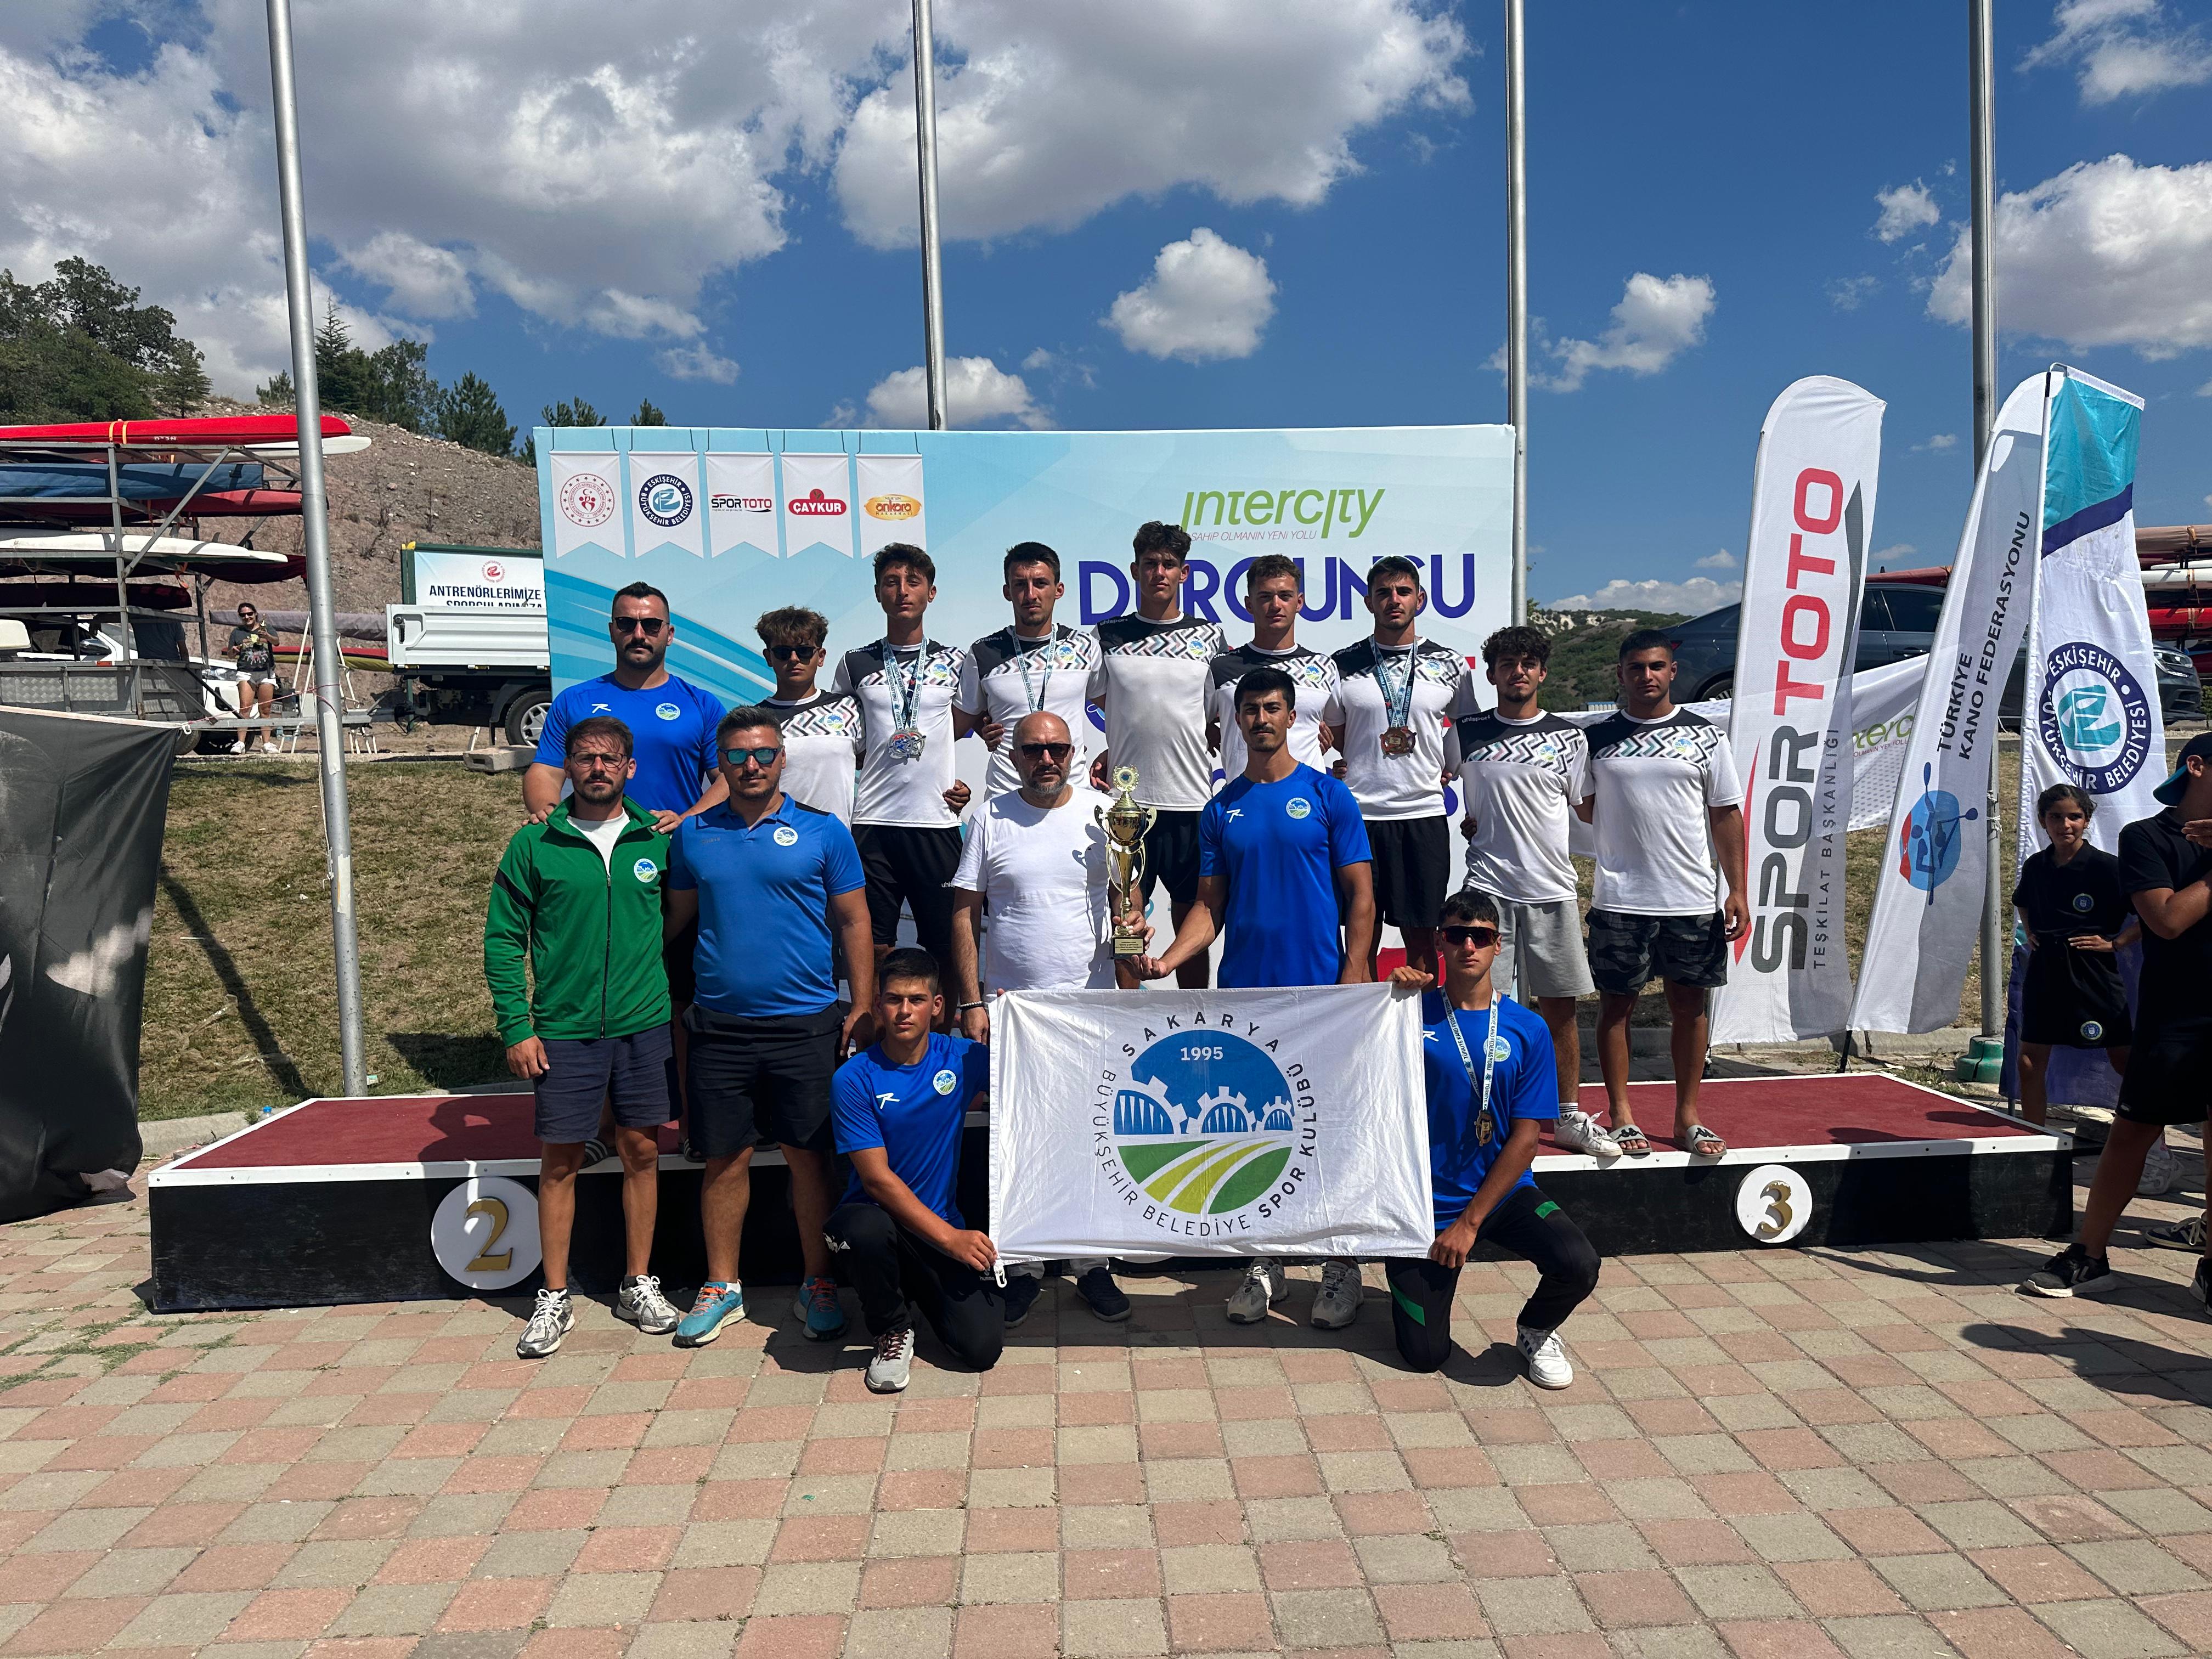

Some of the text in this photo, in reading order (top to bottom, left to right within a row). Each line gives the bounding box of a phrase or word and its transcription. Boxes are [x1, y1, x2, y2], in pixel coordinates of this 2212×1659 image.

[647, 475, 682, 488] ESKİŞEHİR
[640, 493, 670, 526] BÜYÜKŞEHİR
[671, 492, 692, 525] BELEDİYESİ
[793, 502, 842, 514] ÇAYKUR
[876, 500, 912, 512] ankara
[1181, 488, 1386, 539] intercity
[1221, 531, 1265, 541] OLMANIN
[1288, 530, 1317, 540] YOLU
[430, 585, 541, 600] ANTRENÖRLERİMİZE
[1079, 553, 1475, 625] DRUNU
[1099, 618, 1128, 626] uhlsport
[1959, 511, 2030, 760] KANO FEDERASYONU
[2049, 645, 2120, 684] ESKİŞEHİR
[1462, 714, 1491, 723] uhlsport
[1937, 652, 1973, 752] TÜRKİYE
[2042, 690, 2146, 790] ÜYÜKŞEHİR BELEDİYESİ
[1813, 729, 1839, 969] TEŞKİLAT BAŞKANLIĞI
[1122, 1012, 1280, 1057] SAKARYA
[1181, 1046, 1223, 1061] 1995
[1486, 1038, 1496, 1071] FEDERASYONU
[1093, 1062, 1317, 1237] BÜYÜKŞEHİR BELEDİYE SPOR KULÜBÜ
[1758, 1180, 1793, 1237] 3
[464, 1197, 513, 1272] 2
